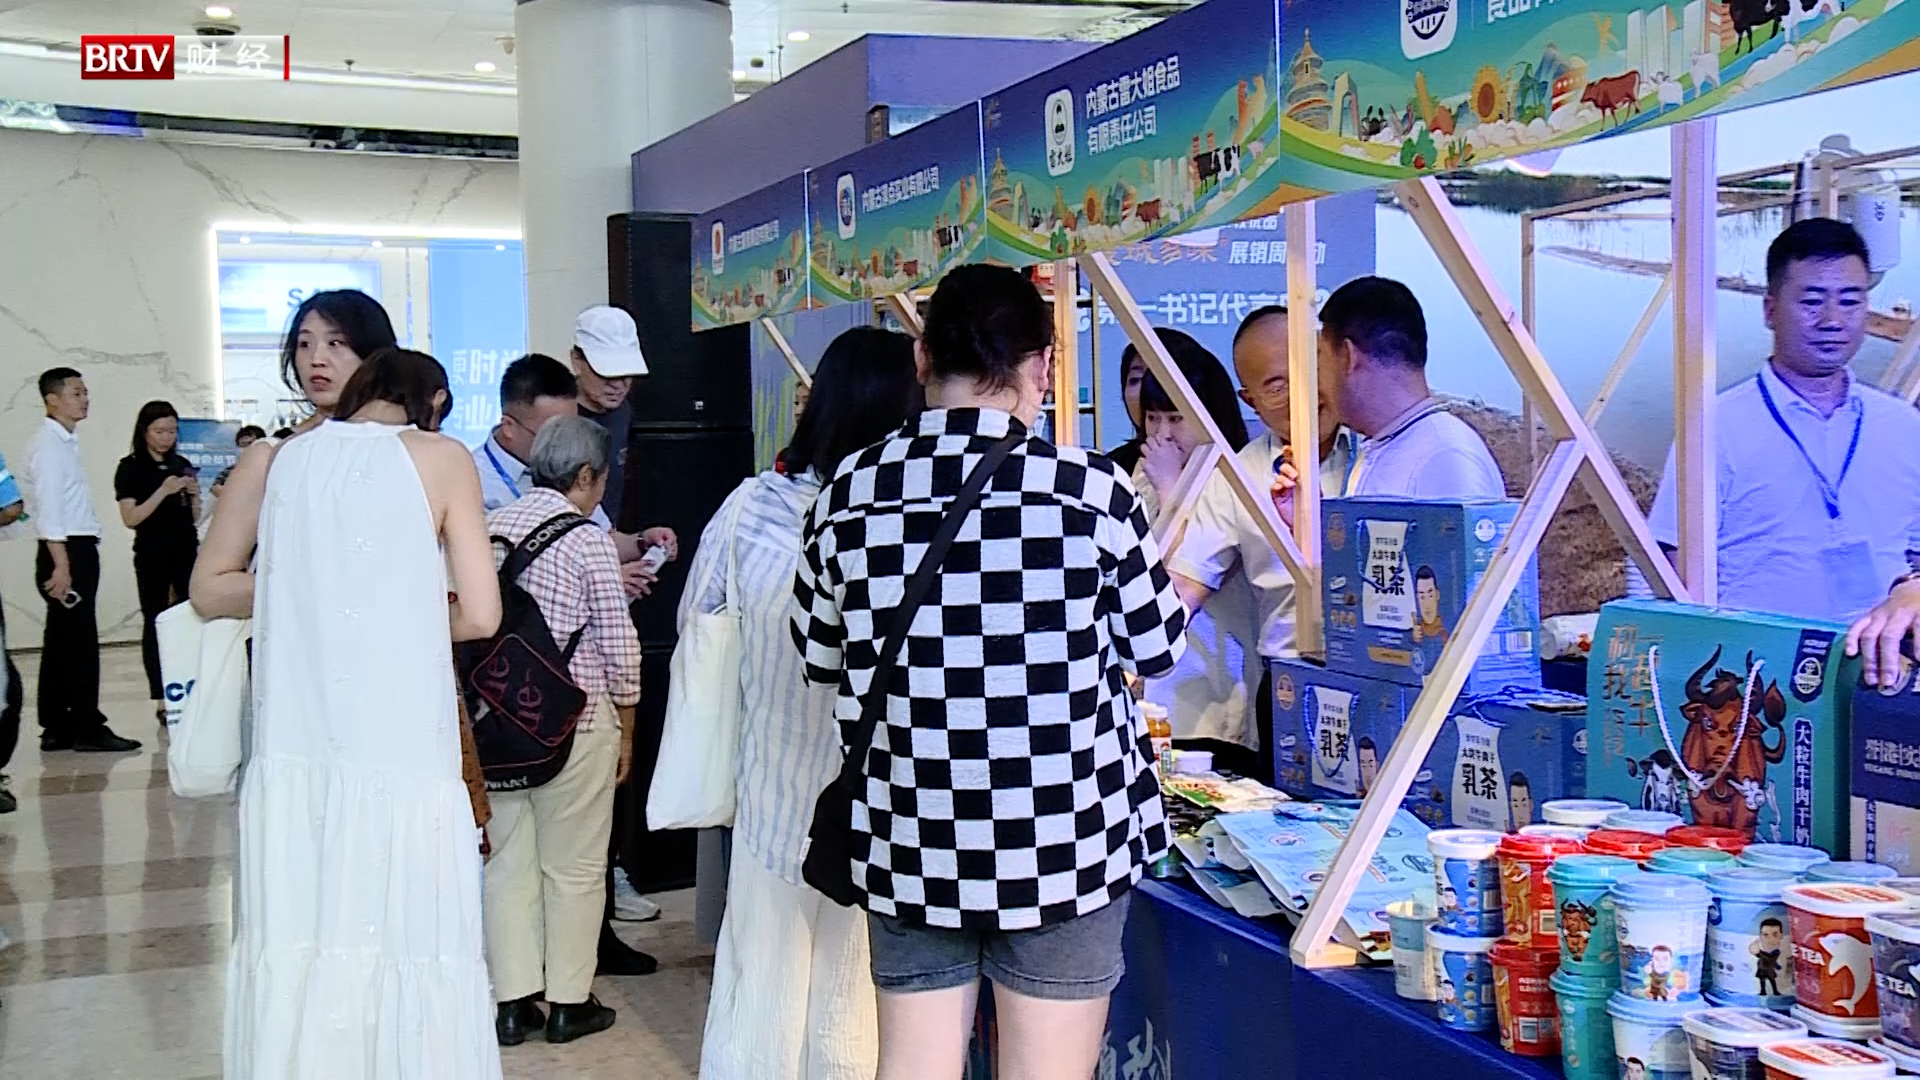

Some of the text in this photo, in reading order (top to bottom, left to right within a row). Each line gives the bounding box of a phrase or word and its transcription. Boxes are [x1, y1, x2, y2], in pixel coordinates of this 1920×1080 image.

[1228, 241, 1327, 264] 展销周动
[1320, 729, 1350, 762] 乳茶
[1462, 763, 1498, 800] 乳茶
[1800, 946, 1826, 966] TEA
[1887, 976, 1918, 999] TEA
